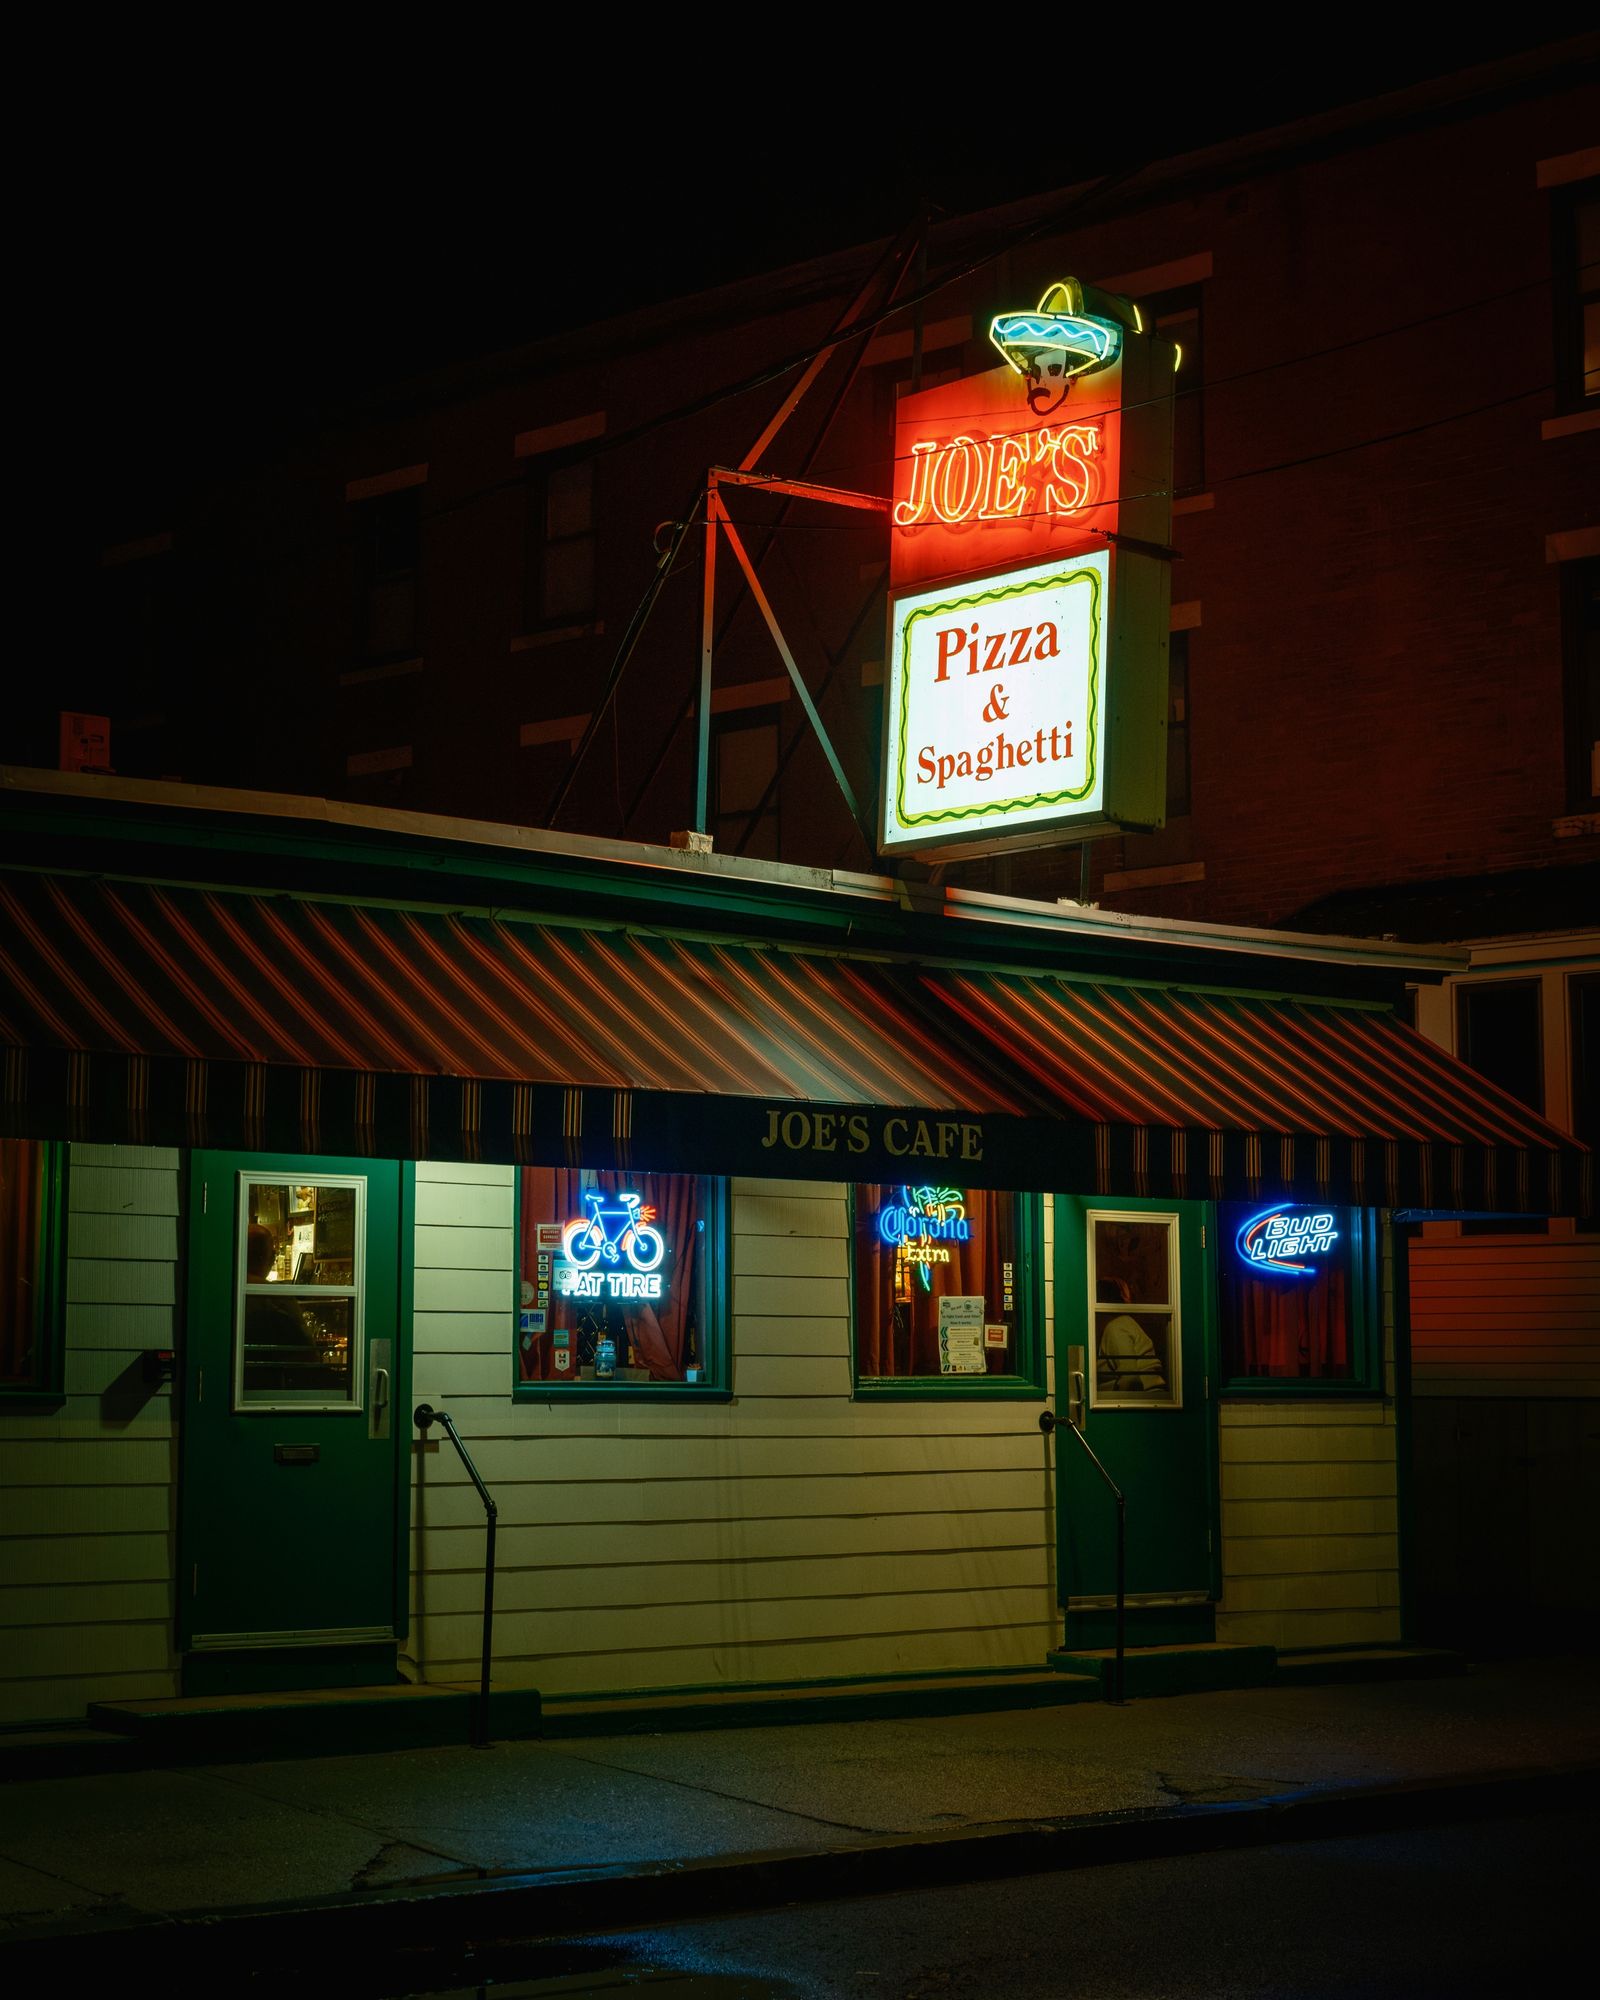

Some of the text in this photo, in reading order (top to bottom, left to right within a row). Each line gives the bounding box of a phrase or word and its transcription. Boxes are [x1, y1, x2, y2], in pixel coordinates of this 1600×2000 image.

[894, 424, 1099, 526] JOE'S
[934, 621, 1061, 683] Pizza
[982, 683, 1010, 723] &
[917, 720, 1074, 789] Spaghetti
[761, 1109, 984, 1161] JOE'S CAFE
[880, 1206, 969, 1247] Corona
[1251, 1231, 1338, 1260] LIGHT
[1266, 1213, 1334, 1239] BUD
[904, 1241, 950, 1262] Extra
[562, 1272, 661, 1297] AT TIRE
